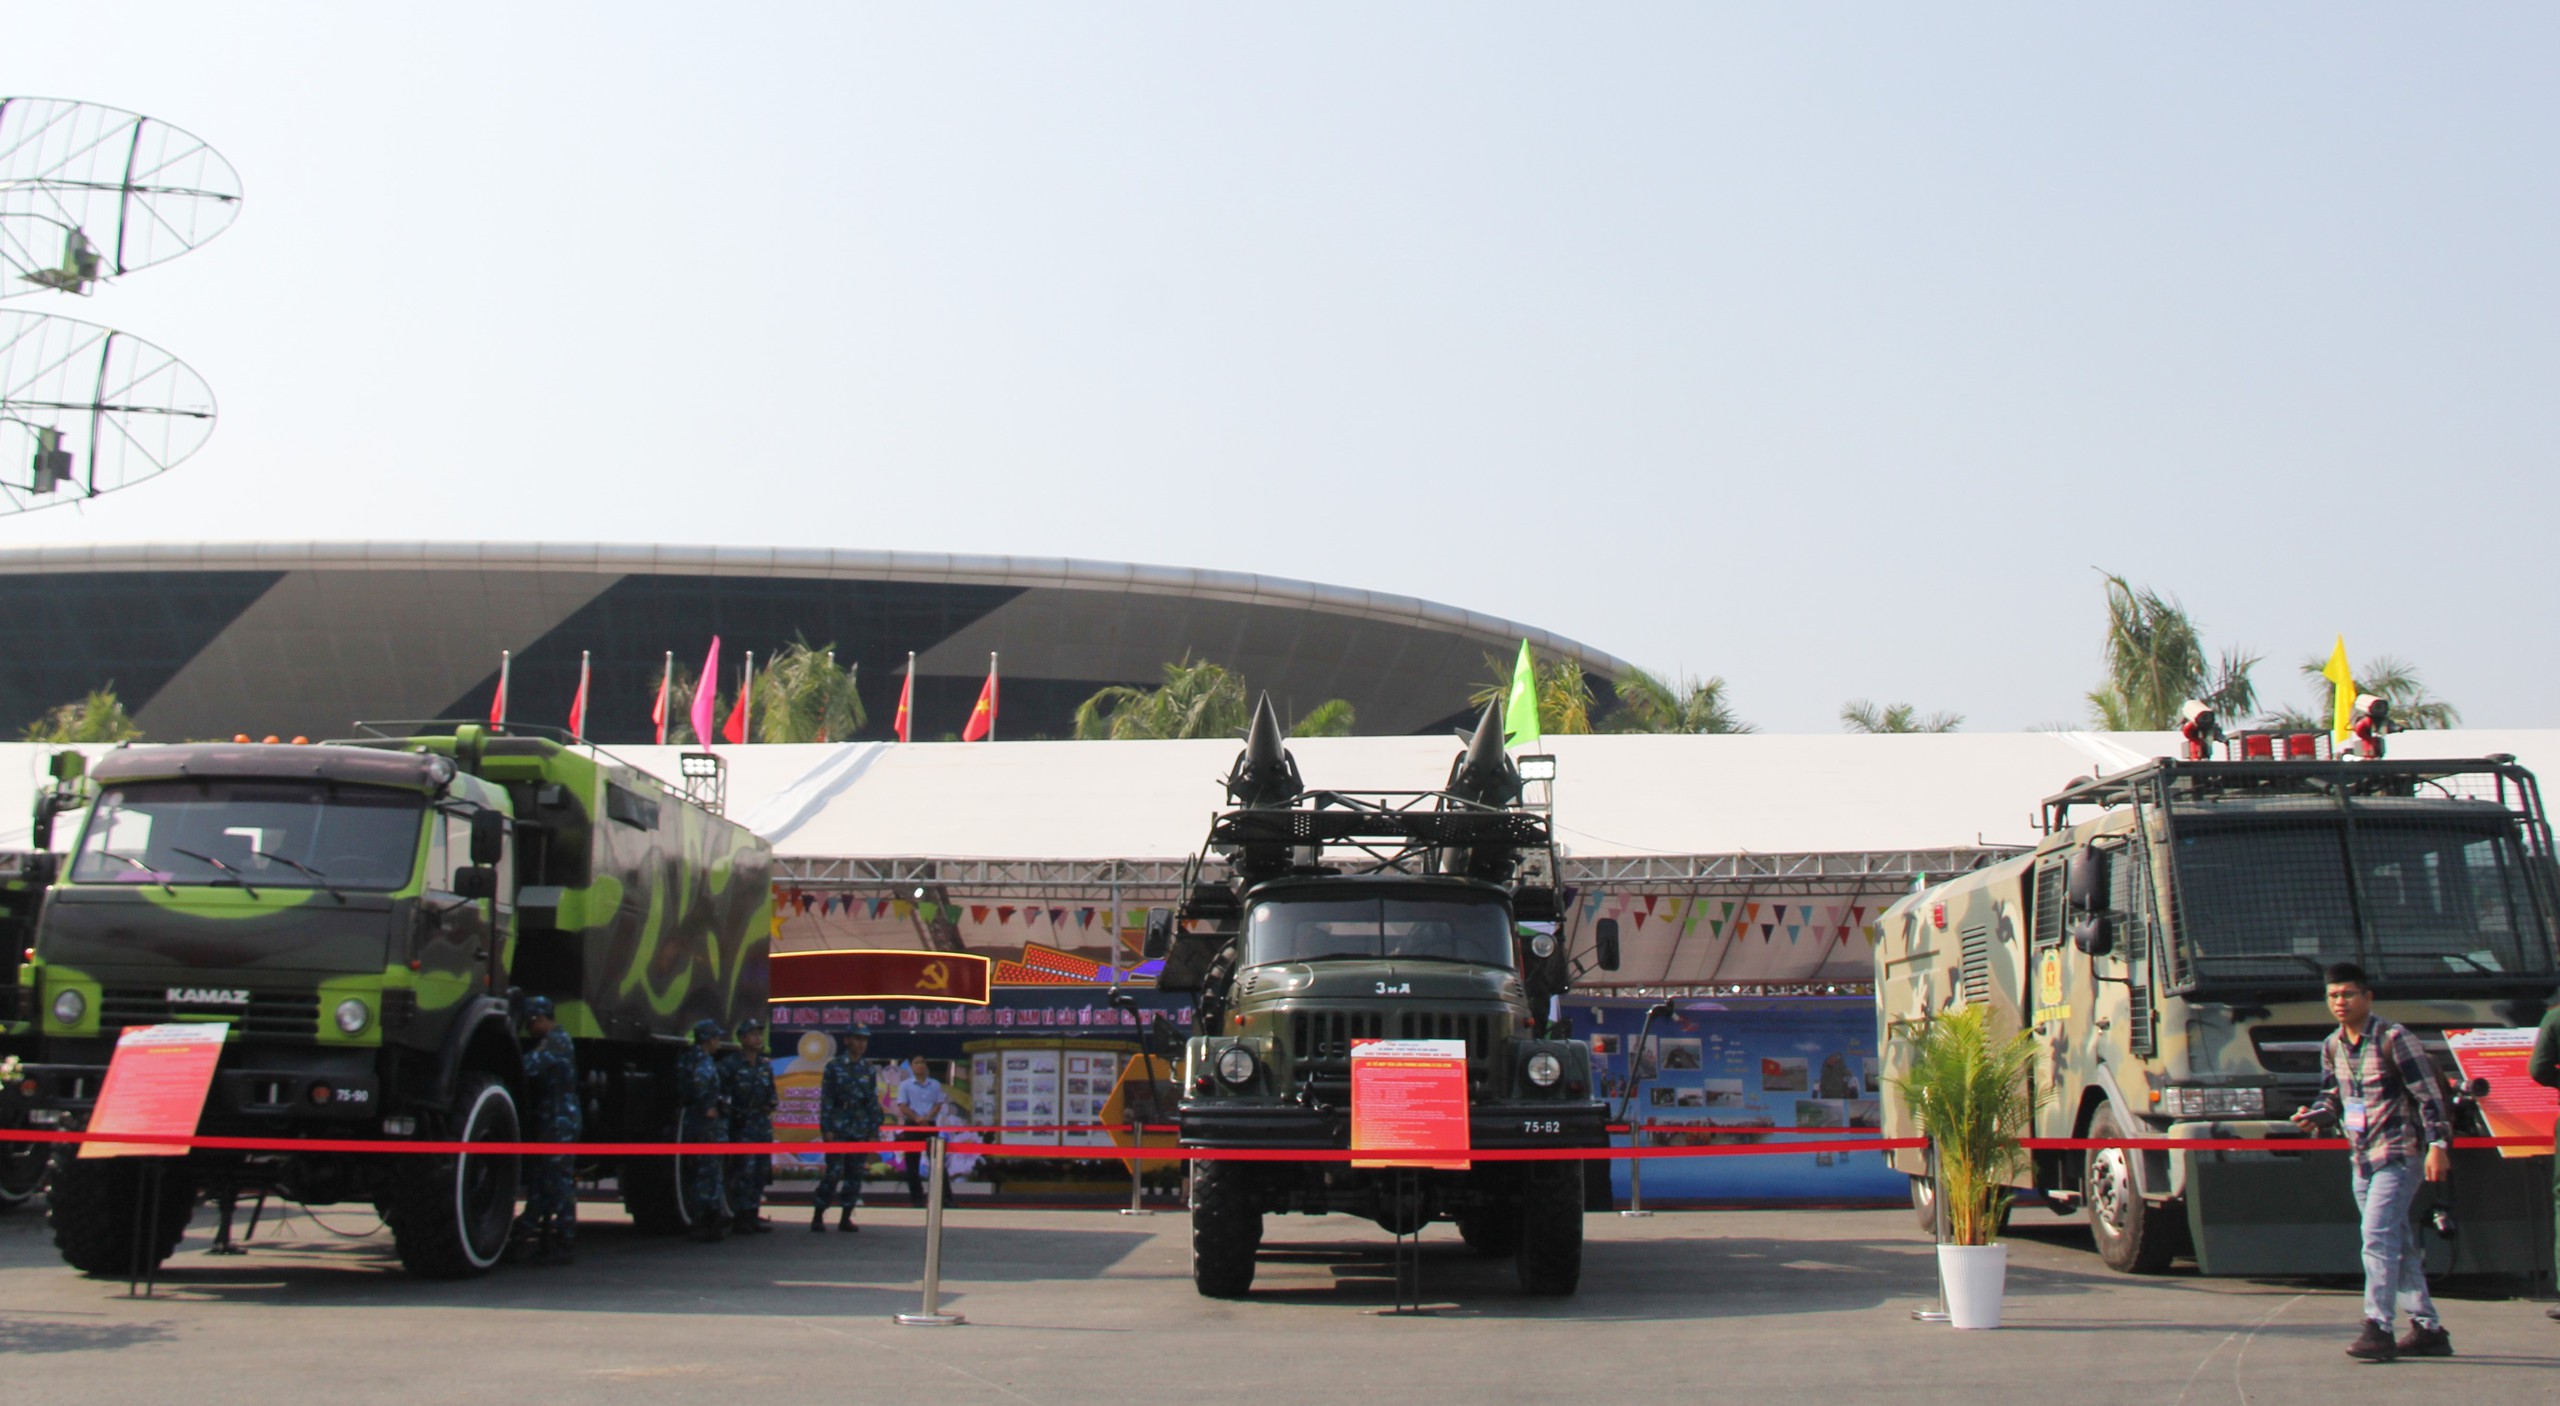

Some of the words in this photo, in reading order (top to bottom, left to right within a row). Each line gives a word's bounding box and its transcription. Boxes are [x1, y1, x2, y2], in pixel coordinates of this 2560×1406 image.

[166, 988, 250, 1004] KAMAZ
[1017, 1008, 1040, 1025] NAM
[336, 1089, 369, 1102] 75-90
